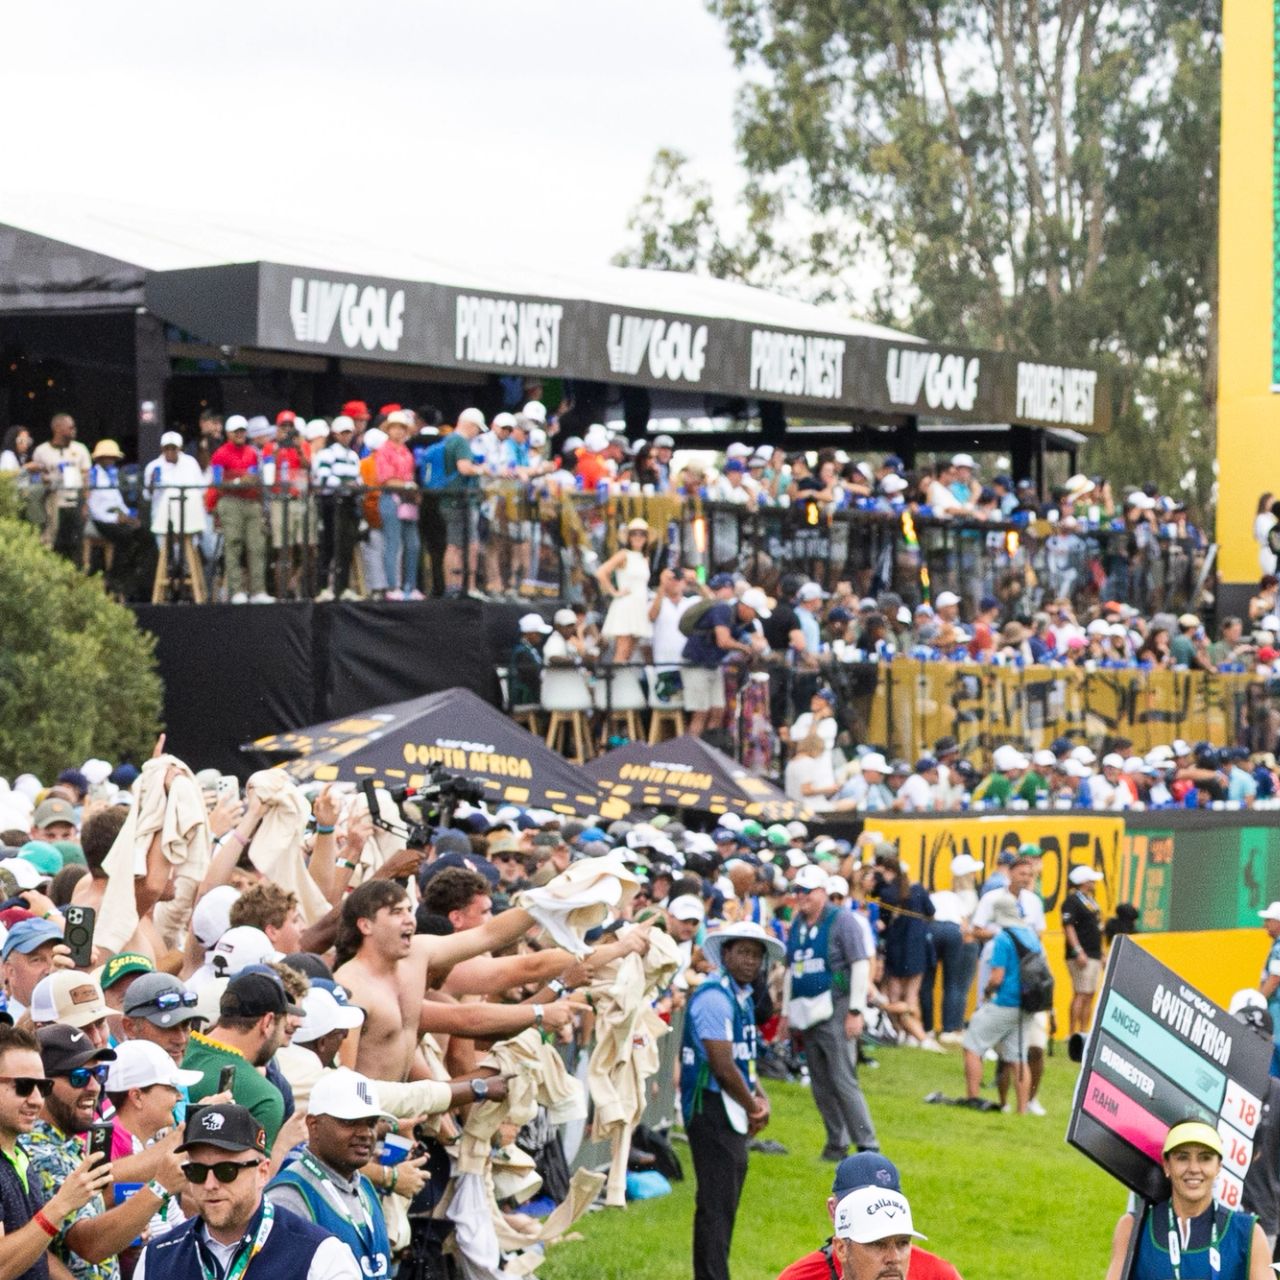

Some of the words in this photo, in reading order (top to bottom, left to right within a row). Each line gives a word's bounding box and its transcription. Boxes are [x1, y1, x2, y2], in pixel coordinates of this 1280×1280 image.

[340, 283, 405, 351] GOLF
[455, 295, 519, 366] PRIDES
[516, 301, 563, 368] NEST
[650, 319, 708, 382] GOLF
[750, 330, 806, 396] PRIDES
[804, 336, 846, 399] NEST
[925, 353, 980, 411] GOLF
[469, 751, 533, 779] AFRICA
[1111, 1006, 1141, 1038] ANCER
[1151, 984, 1193, 1038] SOUTH
[1190, 1012, 1232, 1066] AFRICA
[1100, 1045, 1155, 1097] BURMESTER
[1092, 1087, 1119, 1117] RAHM
[1220, 1181, 1238, 1207] 18
